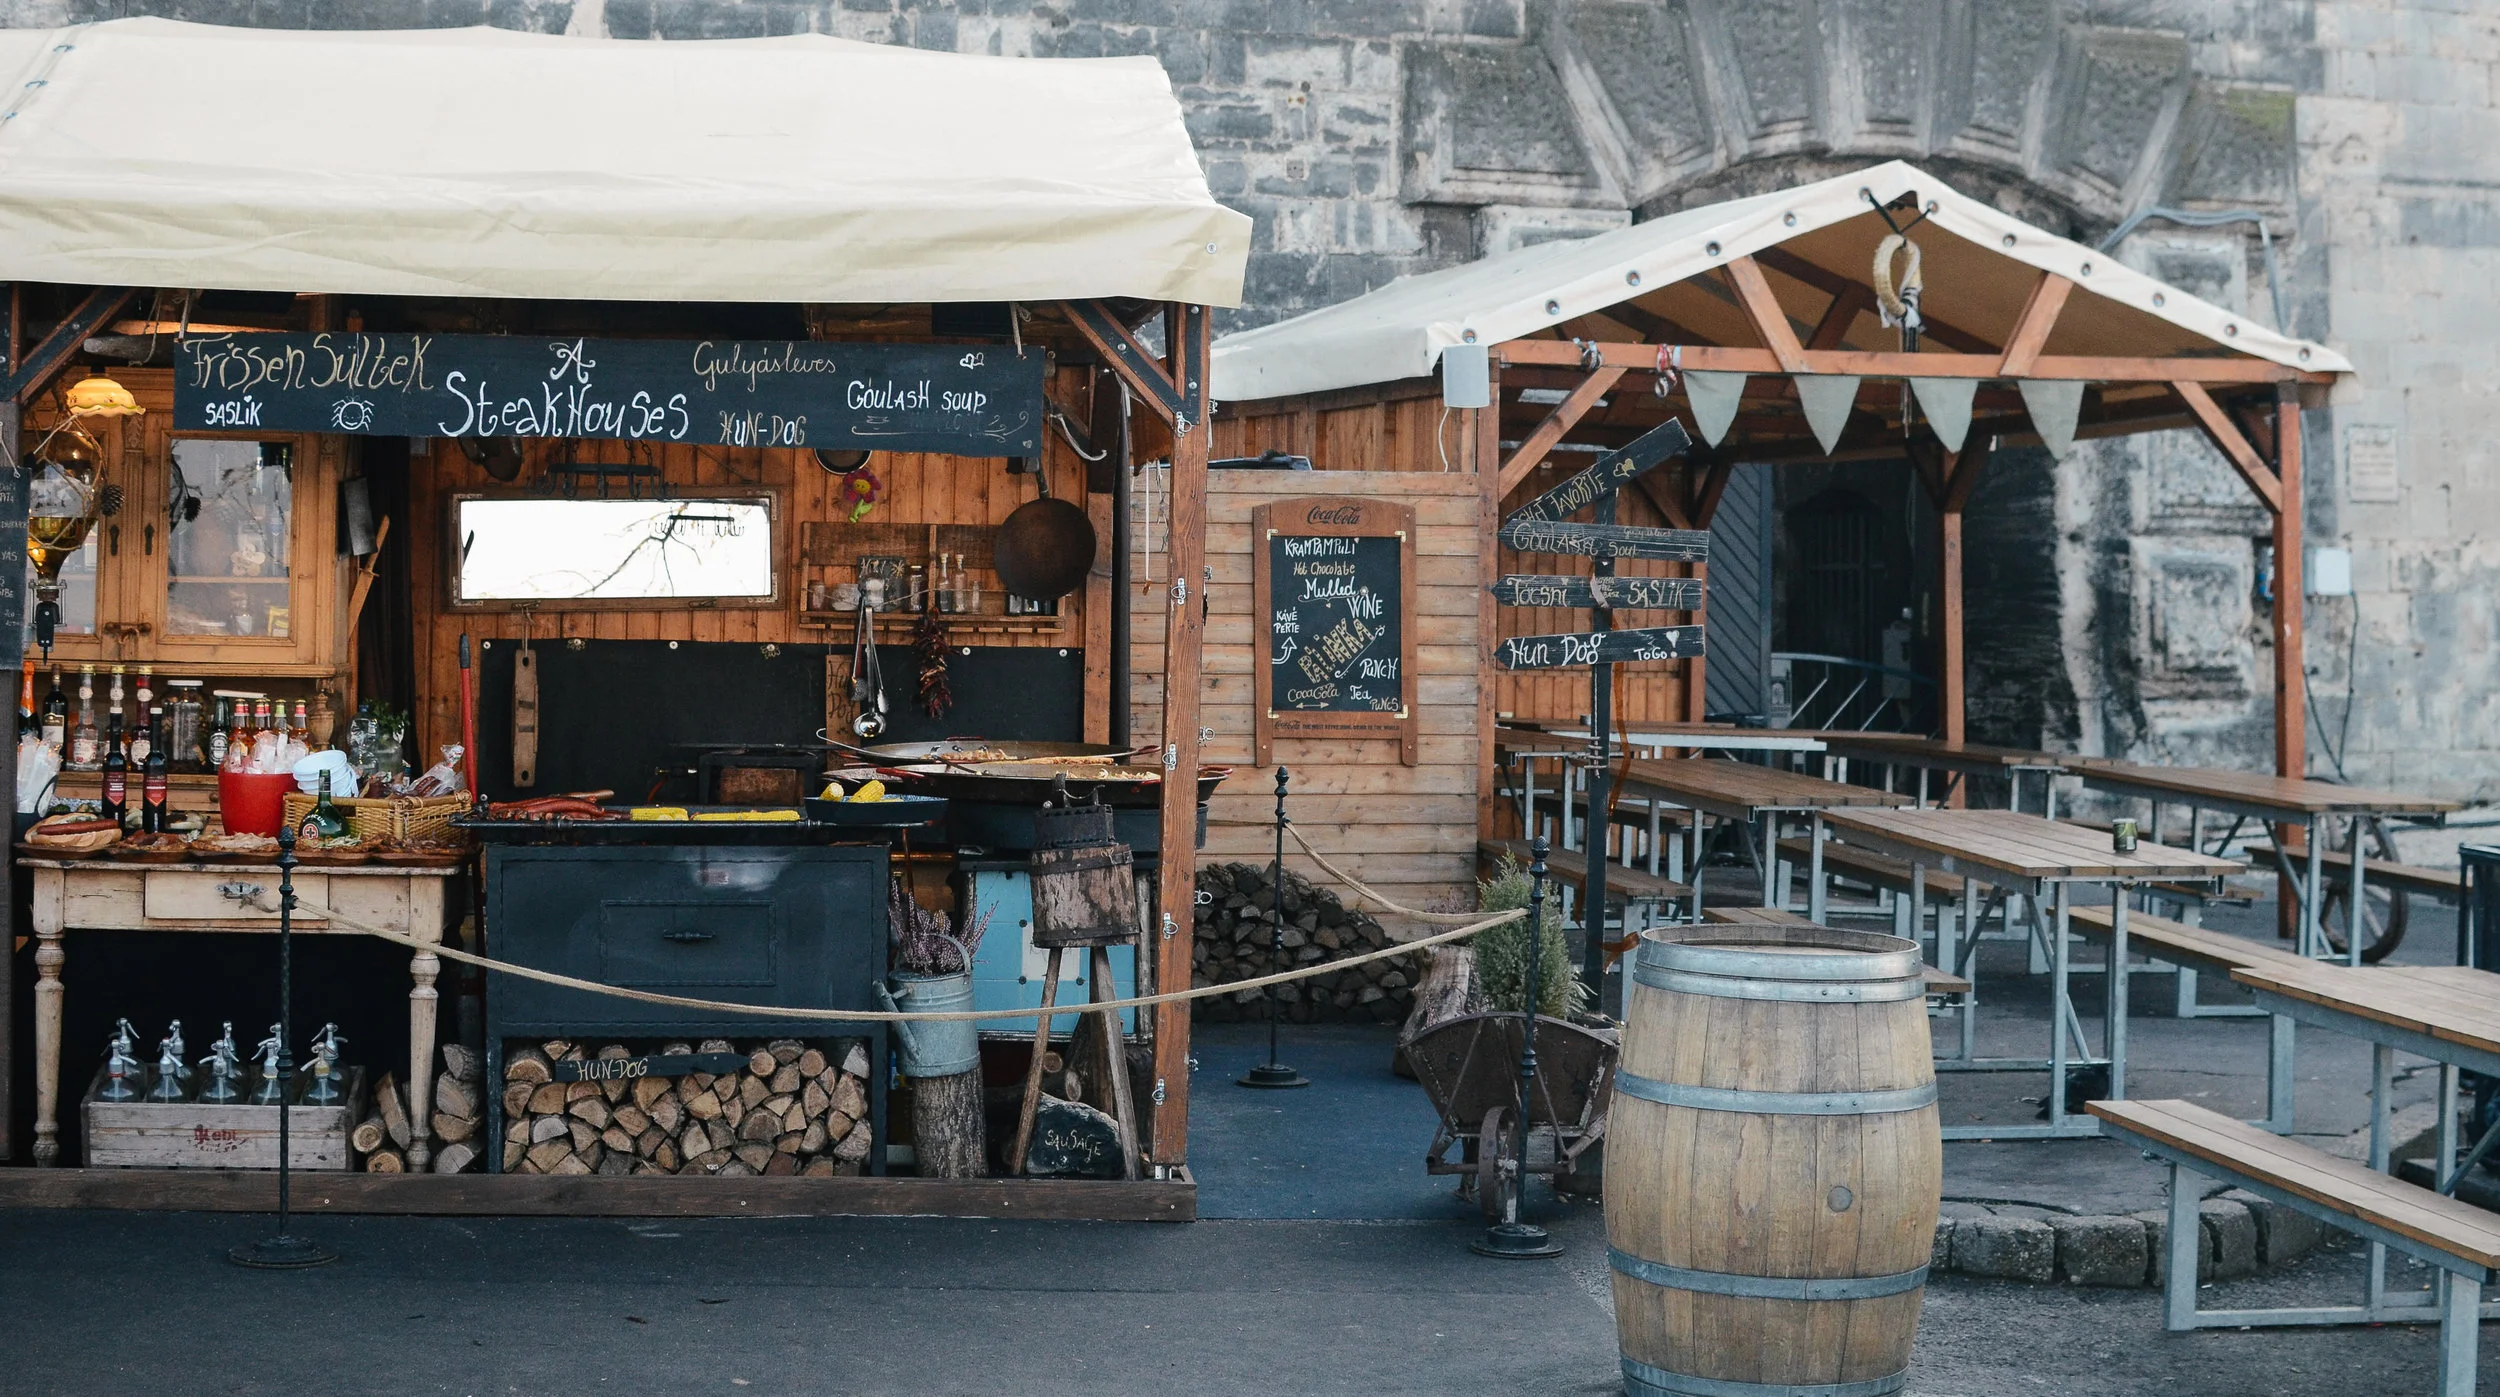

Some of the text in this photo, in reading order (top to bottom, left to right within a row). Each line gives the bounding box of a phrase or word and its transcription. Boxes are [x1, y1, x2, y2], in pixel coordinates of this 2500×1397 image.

[549, 337, 596, 384] A
[1310, 561, 1356, 576] Chocolate
[1303, 575, 1357, 599] Mulled
[1346, 594, 1384, 620] WINE
[1350, 684, 1373, 700] Tea
